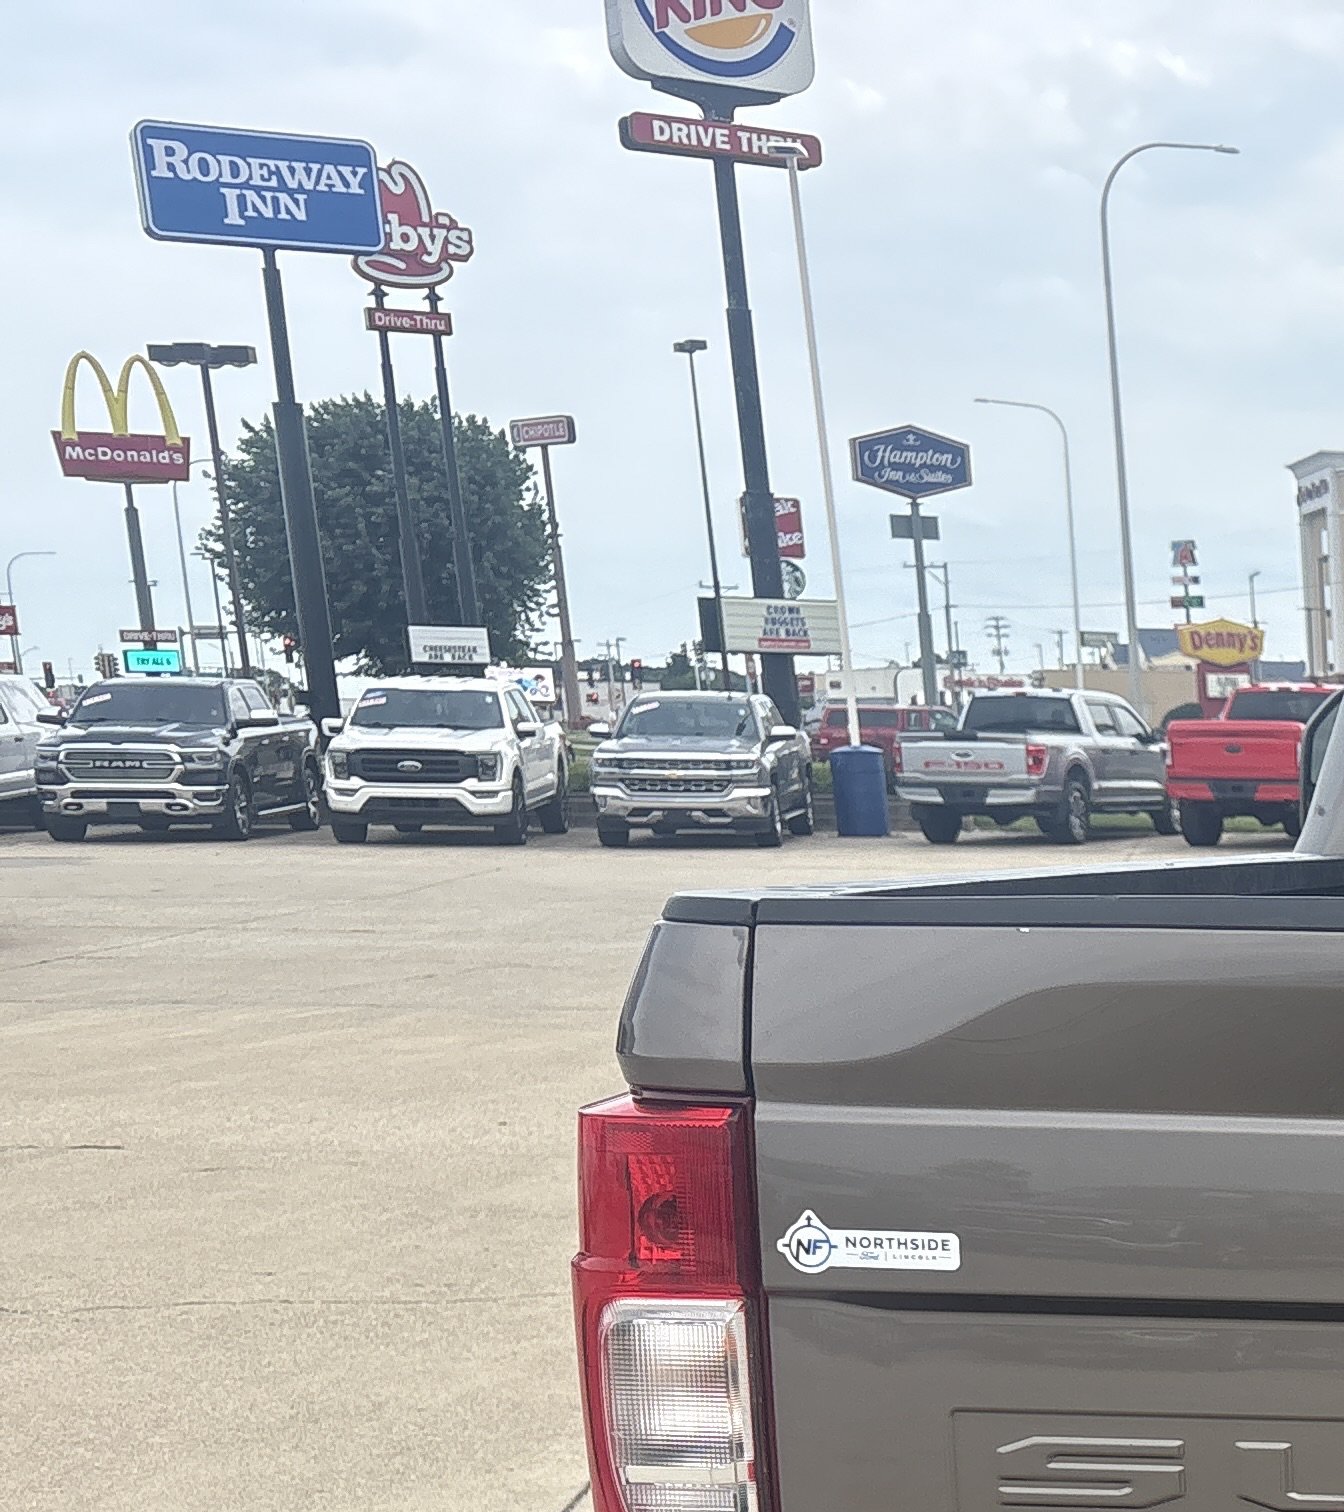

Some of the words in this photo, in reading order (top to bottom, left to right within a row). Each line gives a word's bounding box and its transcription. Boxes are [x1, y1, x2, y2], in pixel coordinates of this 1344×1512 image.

[652, 119, 731, 150] DRIVE
[737, 131, 802, 154] TH
[146, 137, 368, 195] RODEWAY
[219, 187, 308, 226] INN
[384, 213, 472, 265] by's
[374, 311, 447, 331] Drive-Thru
[64, 445, 184, 465] McDonald's
[863, 443, 962, 468] Hampton
[873, 467, 907, 483] Inn
[918, 468, 953, 483] Suites
[1190, 630, 1260, 653] Denny's
[94, 760, 141, 768] RAM
[845, 1236, 951, 1251] NORTHSIDE
